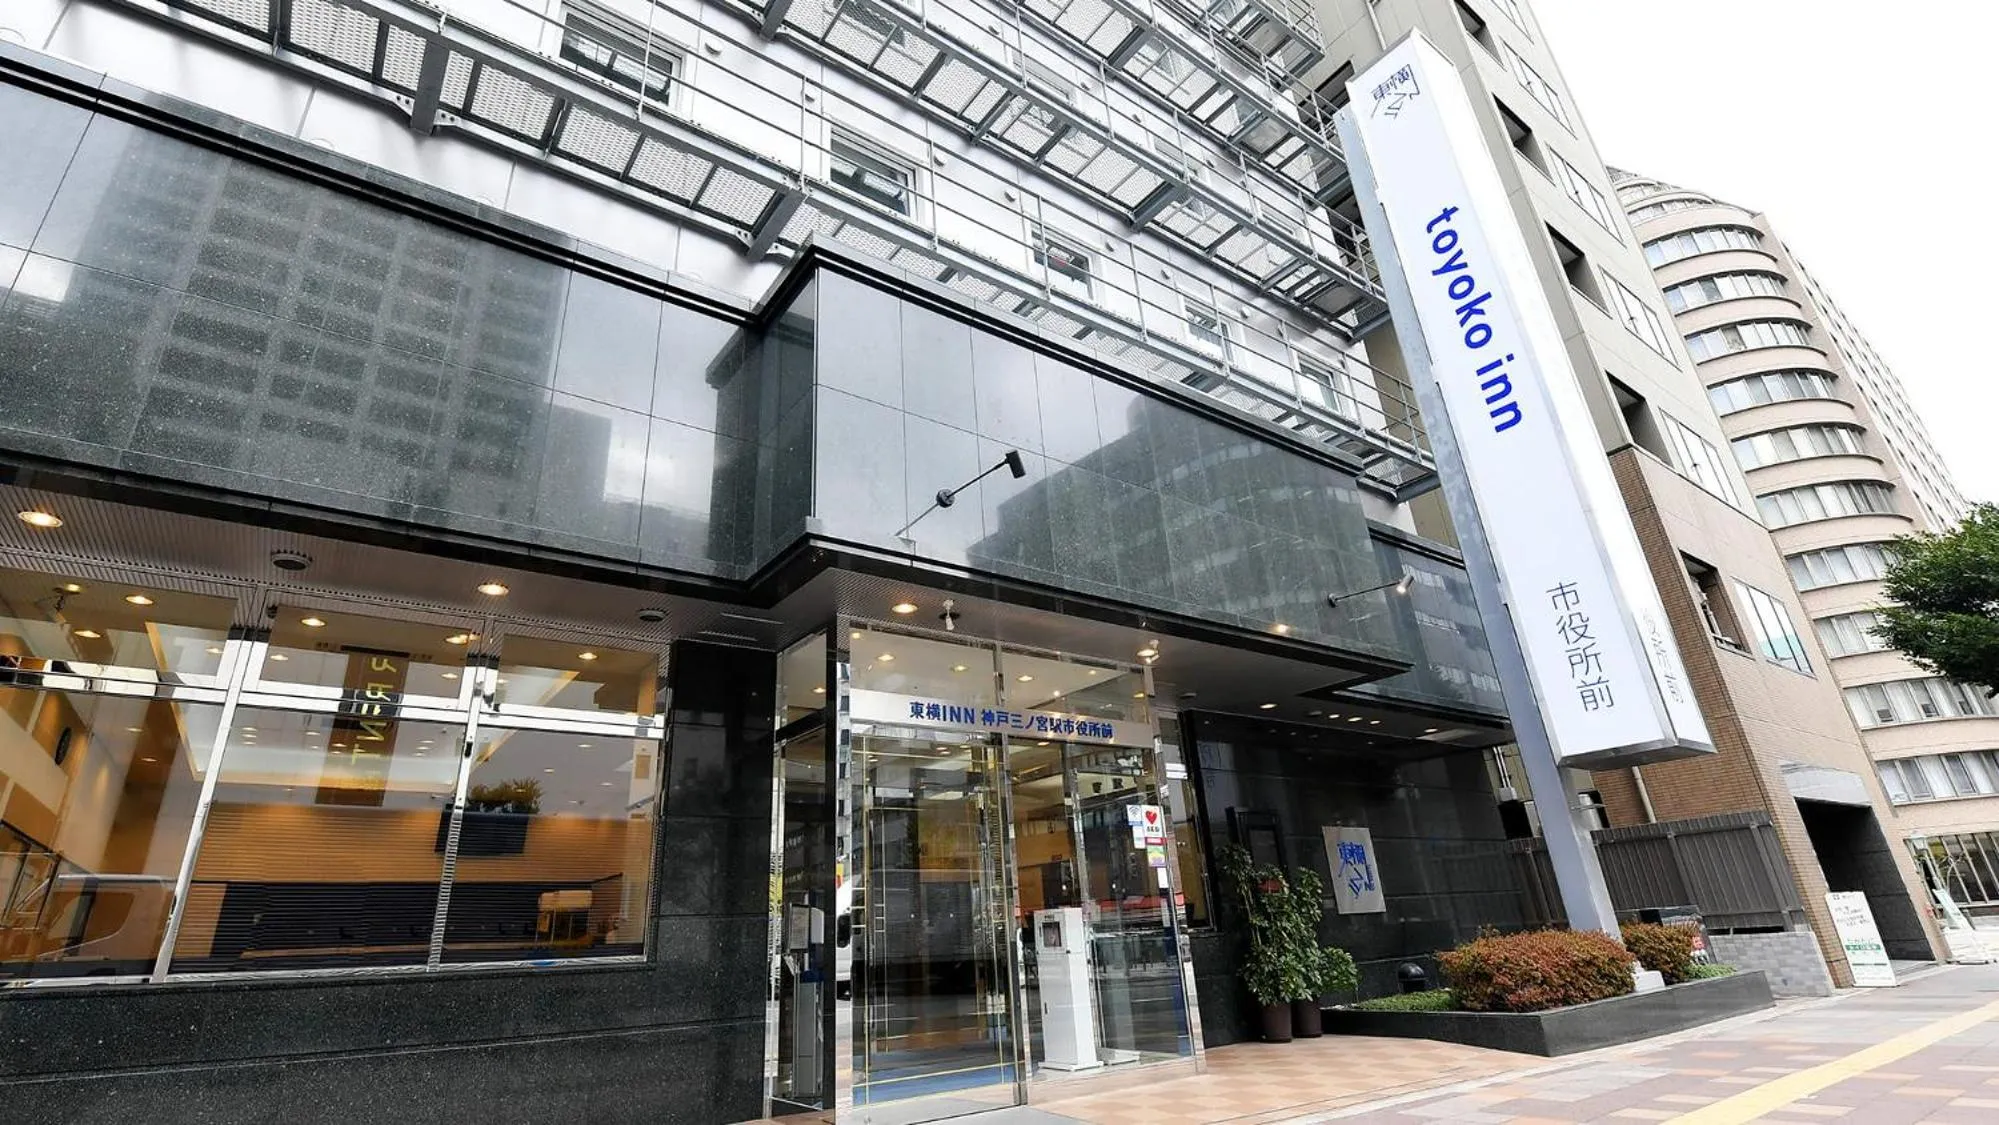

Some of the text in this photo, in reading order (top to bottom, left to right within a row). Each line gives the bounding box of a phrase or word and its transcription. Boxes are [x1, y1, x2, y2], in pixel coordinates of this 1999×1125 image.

[1426, 205, 1524, 433] toyoko inn
[1546, 581, 1615, 713] 市役所前
[909, 701, 1114, 739] 東横INN 神戸三ノ宮駅市役所前
